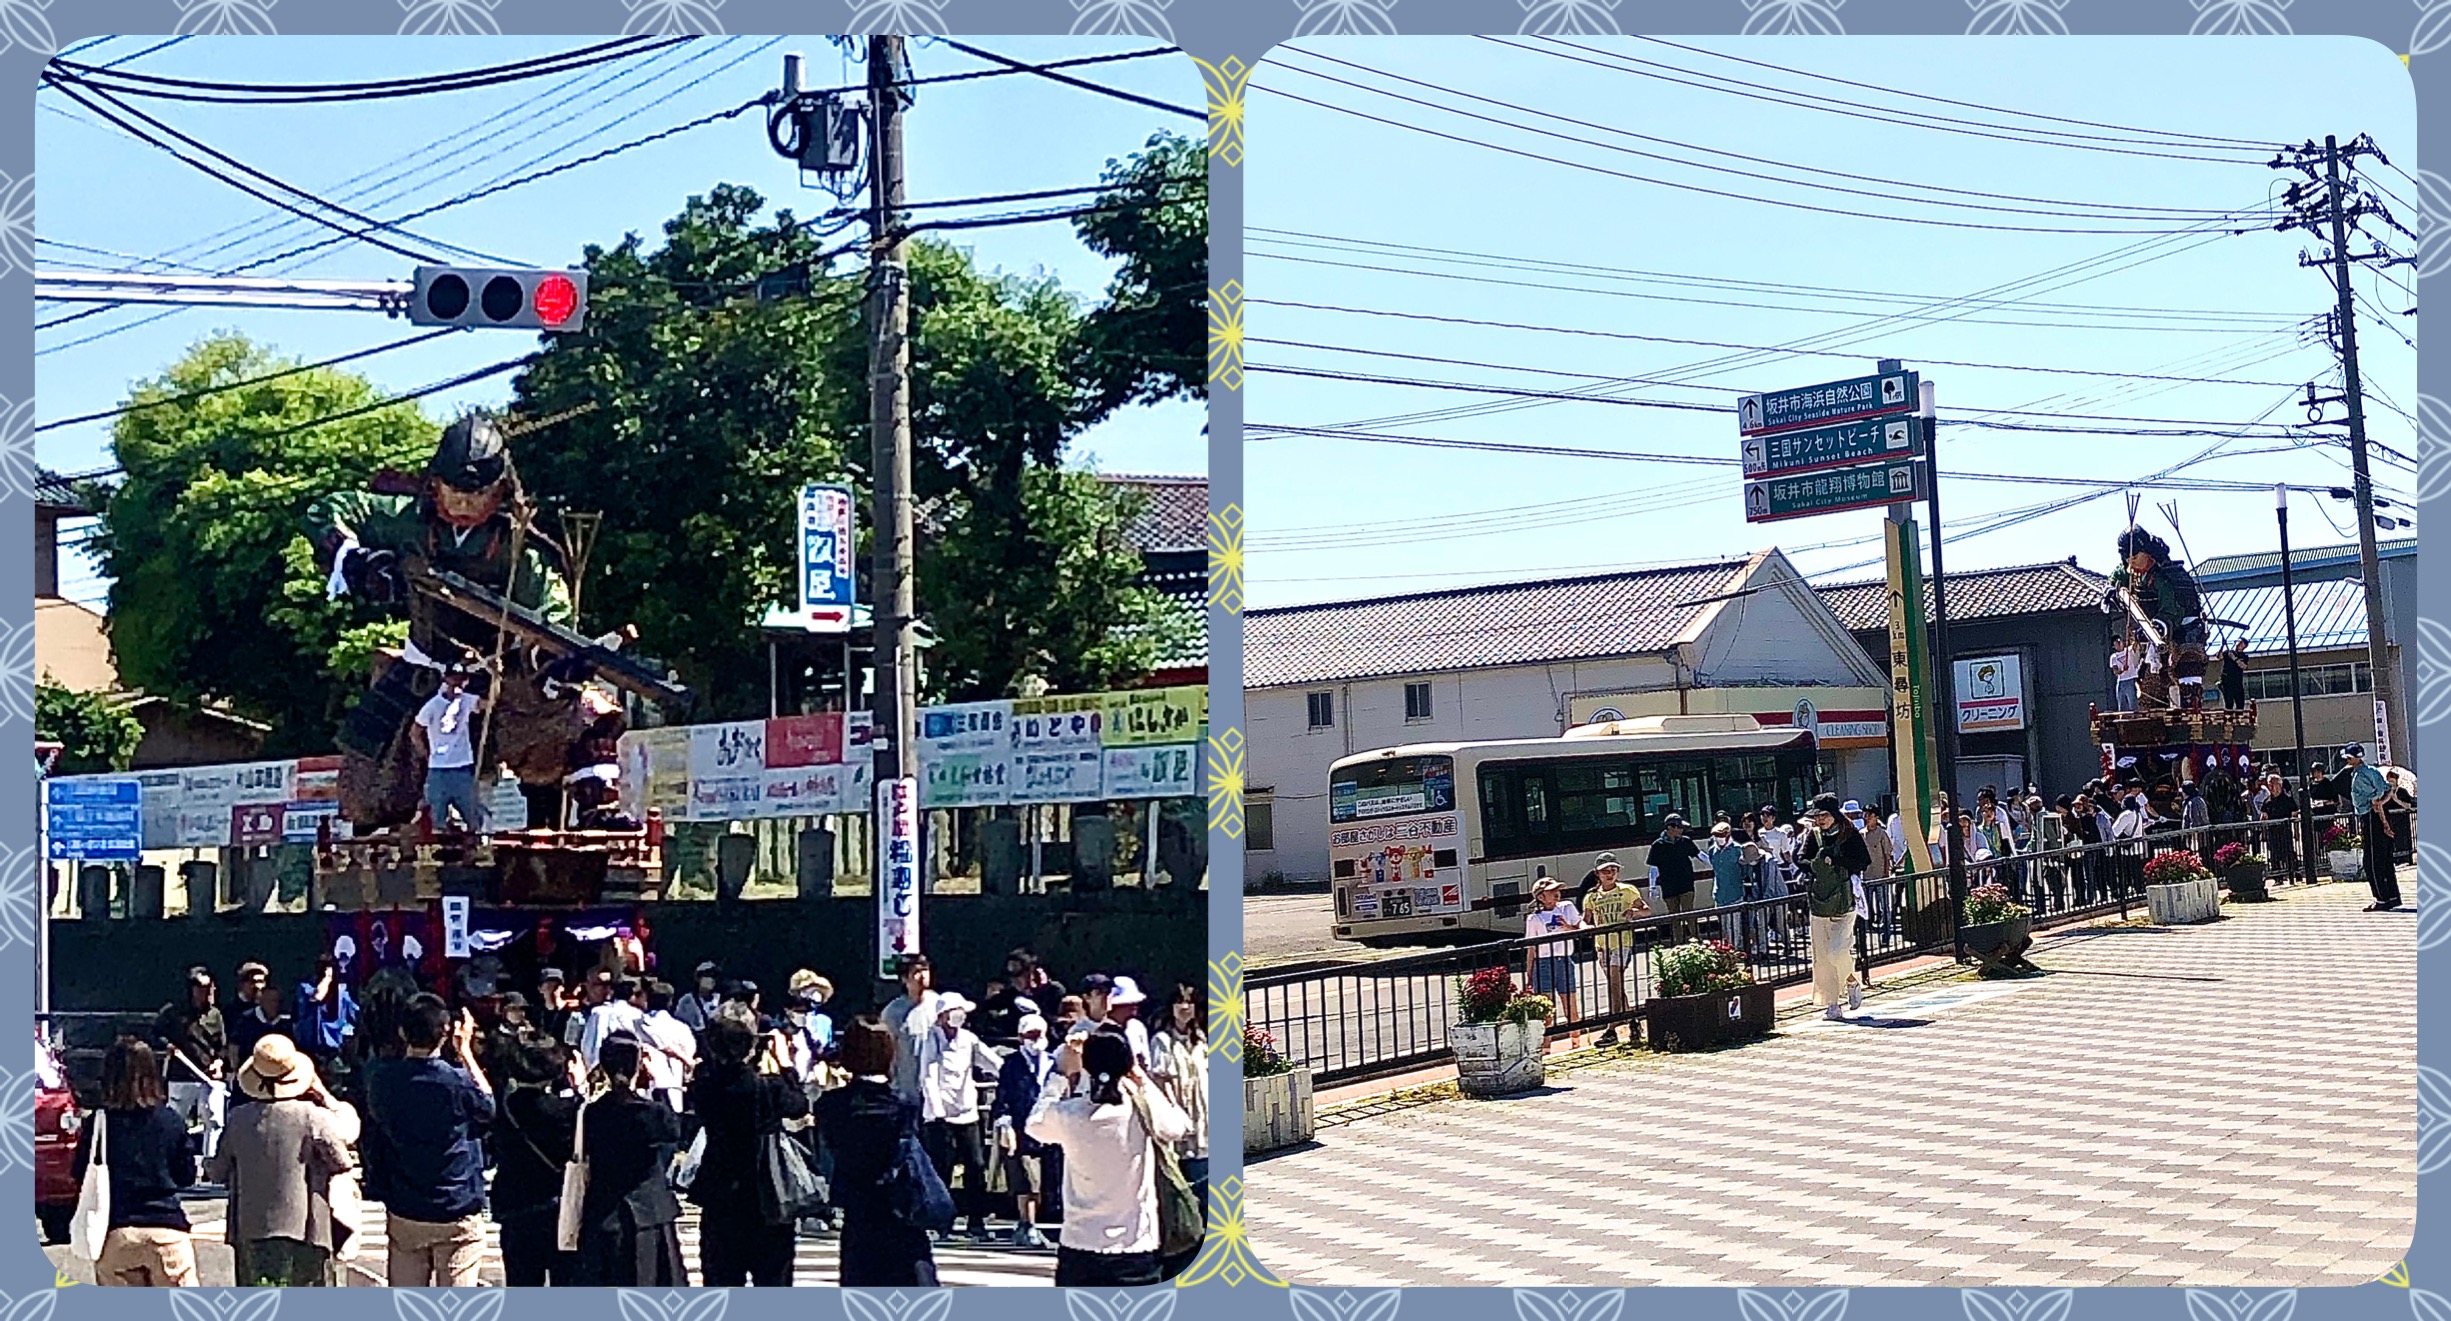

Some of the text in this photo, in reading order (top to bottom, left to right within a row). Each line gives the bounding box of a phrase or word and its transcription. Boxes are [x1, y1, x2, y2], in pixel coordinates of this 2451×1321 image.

[1766, 382, 1873, 416] 坂井市海浜自然公園
[1742, 421, 1763, 430] 4.6km
[1768, 402, 1873, 426] Sakai City Seaside Nature Park
[1771, 425, 1880, 459] 三国サンセットビーチ
[1772, 446, 1874, 469] Mikuni Sunset Beach
[1773, 470, 1885, 501] 坂井市龍翔博物館
[1749, 505, 1768, 516] 750m
[1791, 493, 1868, 509] Sakai City Museum
[1892, 651, 1911, 719] 東尋坊
[1962, 705, 2018, 722] クリーニング
[1826, 723, 1881, 737] CLEANING SHOP
